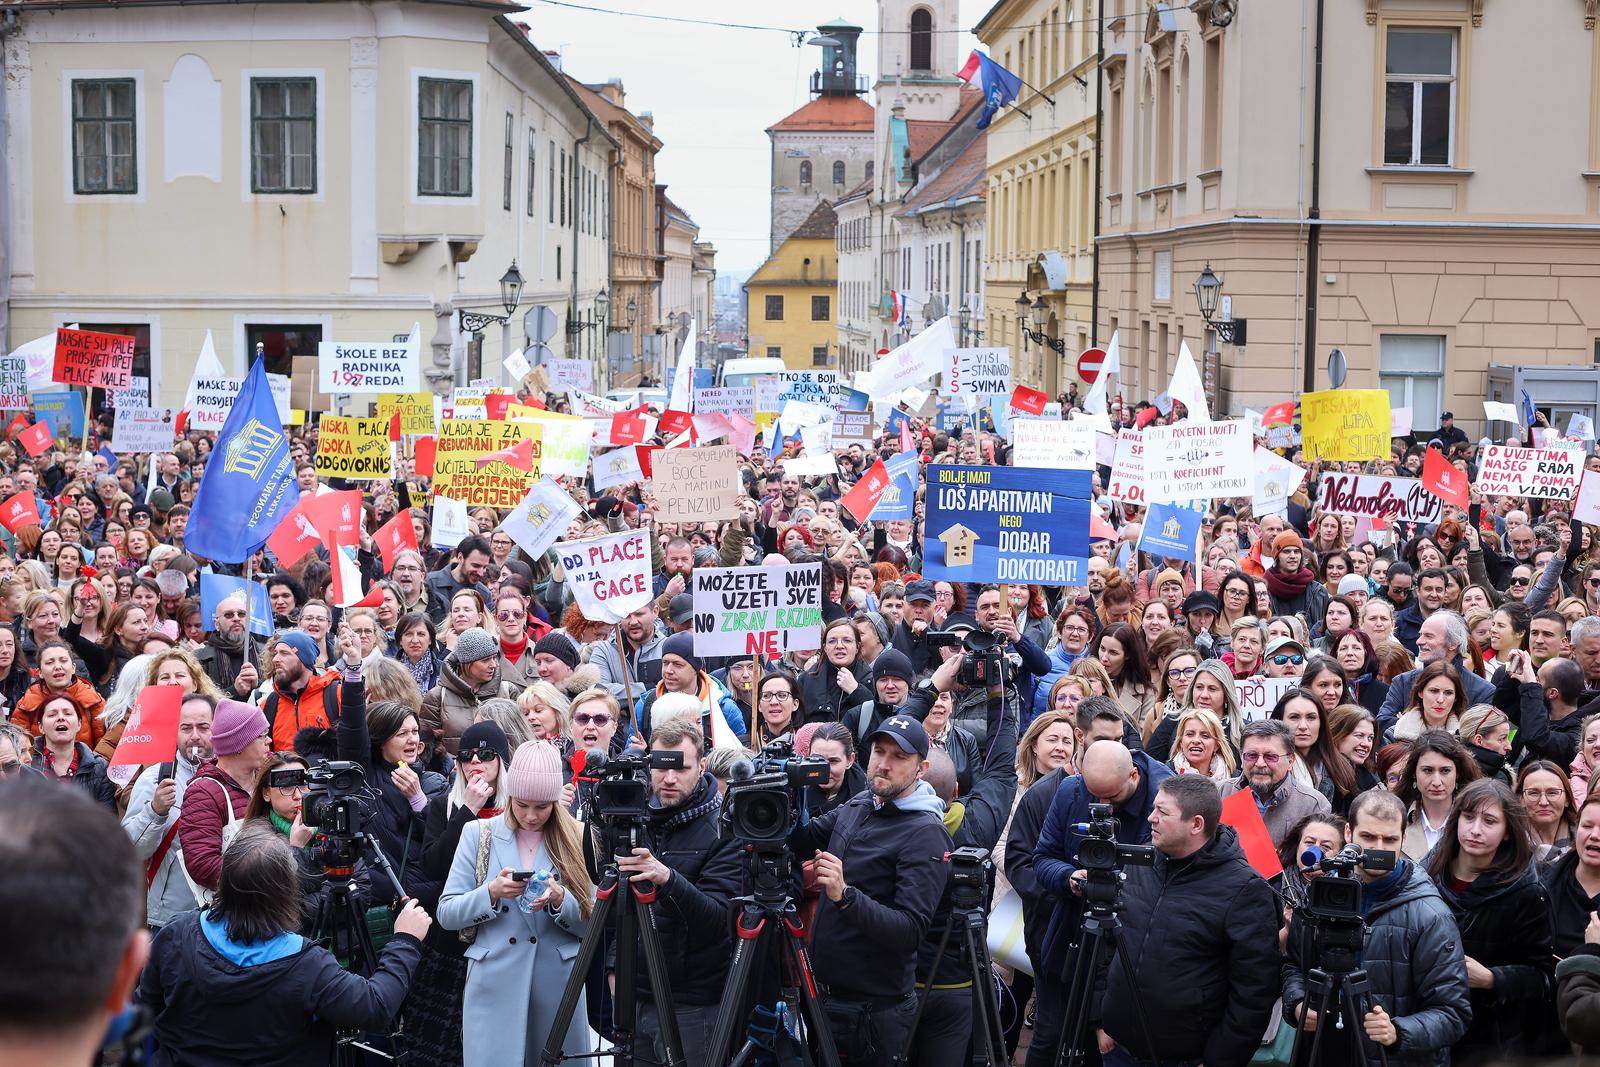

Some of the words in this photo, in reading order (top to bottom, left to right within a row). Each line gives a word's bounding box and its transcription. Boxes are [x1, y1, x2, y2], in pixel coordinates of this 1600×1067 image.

[57, 330, 92, 350] MASKE
[94, 338, 108, 350] SU
[111, 338, 134, 354] PALE
[336, 346, 377, 358] ŠKOLE
[382, 349, 408, 358] BEZ
[952, 355, 958, 365] V
[976, 352, 998, 364] VIŠI
[112, 354, 132, 370] OPET
[342, 362, 401, 372] RADNIKA
[100, 372, 127, 387] MALE
[779, 372, 798, 382] TKO
[801, 374, 812, 382] SE
[818, 374, 836, 382] BOJI
[952, 368, 959, 378] S
[197, 380, 226, 390] MASKE
[228, 381, 239, 392] SU
[366, 376, 404, 386] REDA!
[794, 384, 824, 394] FUKSA
[828, 382, 840, 395] JOŠ
[951, 380, 960, 392] S
[970, 380, 1006, 392] SVIMA
[396, 394, 415, 404] ZA
[701, 390, 722, 398] NERED
[847, 414, 868, 422] VLADE
[320, 420, 349, 435] NISKA
[442, 423, 472, 436] VLADA
[476, 422, 492, 436] JE
[502, 424, 522, 438] ZA
[438, 437, 493, 452] REDUCIRANI
[1488, 446, 1498, 457] O
[1504, 448, 1568, 462] UVJETIMA
[672, 464, 707, 480] BOCE
[1174, 466, 1225, 480] KOEFICIJENT
[1484, 458, 1528, 471] NAŠEG
[1537, 462, 1574, 474] RADA
[451, 474, 527, 490] REDUCIRANE
[940, 470, 966, 484] BOLJE
[966, 471, 991, 484] IMATI
[1482, 471, 1523, 484] NEMA
[1532, 475, 1574, 487] POJMA
[660, 483, 678, 493] ZA
[685, 478, 729, 492] MAMINU
[1164, 484, 1170, 494] U
[1480, 482, 1509, 492] OVA
[1519, 485, 1570, 498] VLADA
[938, 484, 966, 511] LOŠ
[968, 490, 1052, 514] APARTMAN
[1321, 476, 1407, 518] Nedovoljan
[668, 496, 720, 514] PENZIJU
[999, 514, 1022, 528] NEGO
[998, 530, 1050, 554] DOBAR
[562, 554, 584, 570] OD
[588, 538, 644, 566] PLAĆE
[576, 574, 585, 582] NI
[588, 571, 601, 581] ZA
[997, 558, 1078, 582] DOKTORAT!
[594, 574, 646, 600] GAĆE
[698, 570, 768, 592] MOŽETE
[786, 568, 821, 588] NAM
[722, 590, 778, 610] UZETI
[694, 613, 715, 634] NO
[776, 608, 822, 629] RAZUM
